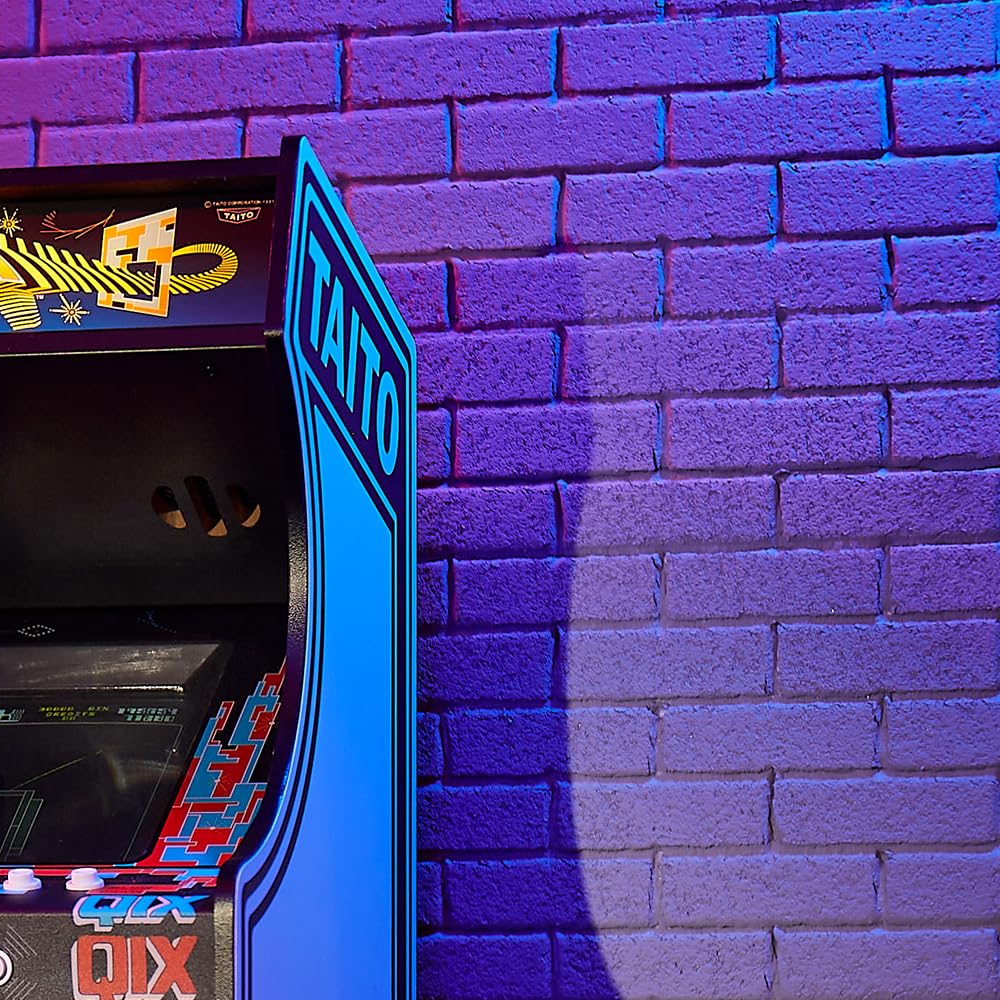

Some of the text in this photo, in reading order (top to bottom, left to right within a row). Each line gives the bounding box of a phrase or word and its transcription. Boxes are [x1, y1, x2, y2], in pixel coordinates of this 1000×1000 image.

[224, 211, 254, 221] TAITO
[308, 229, 400, 476] TAITO
[72, 894, 209, 932] QIX
